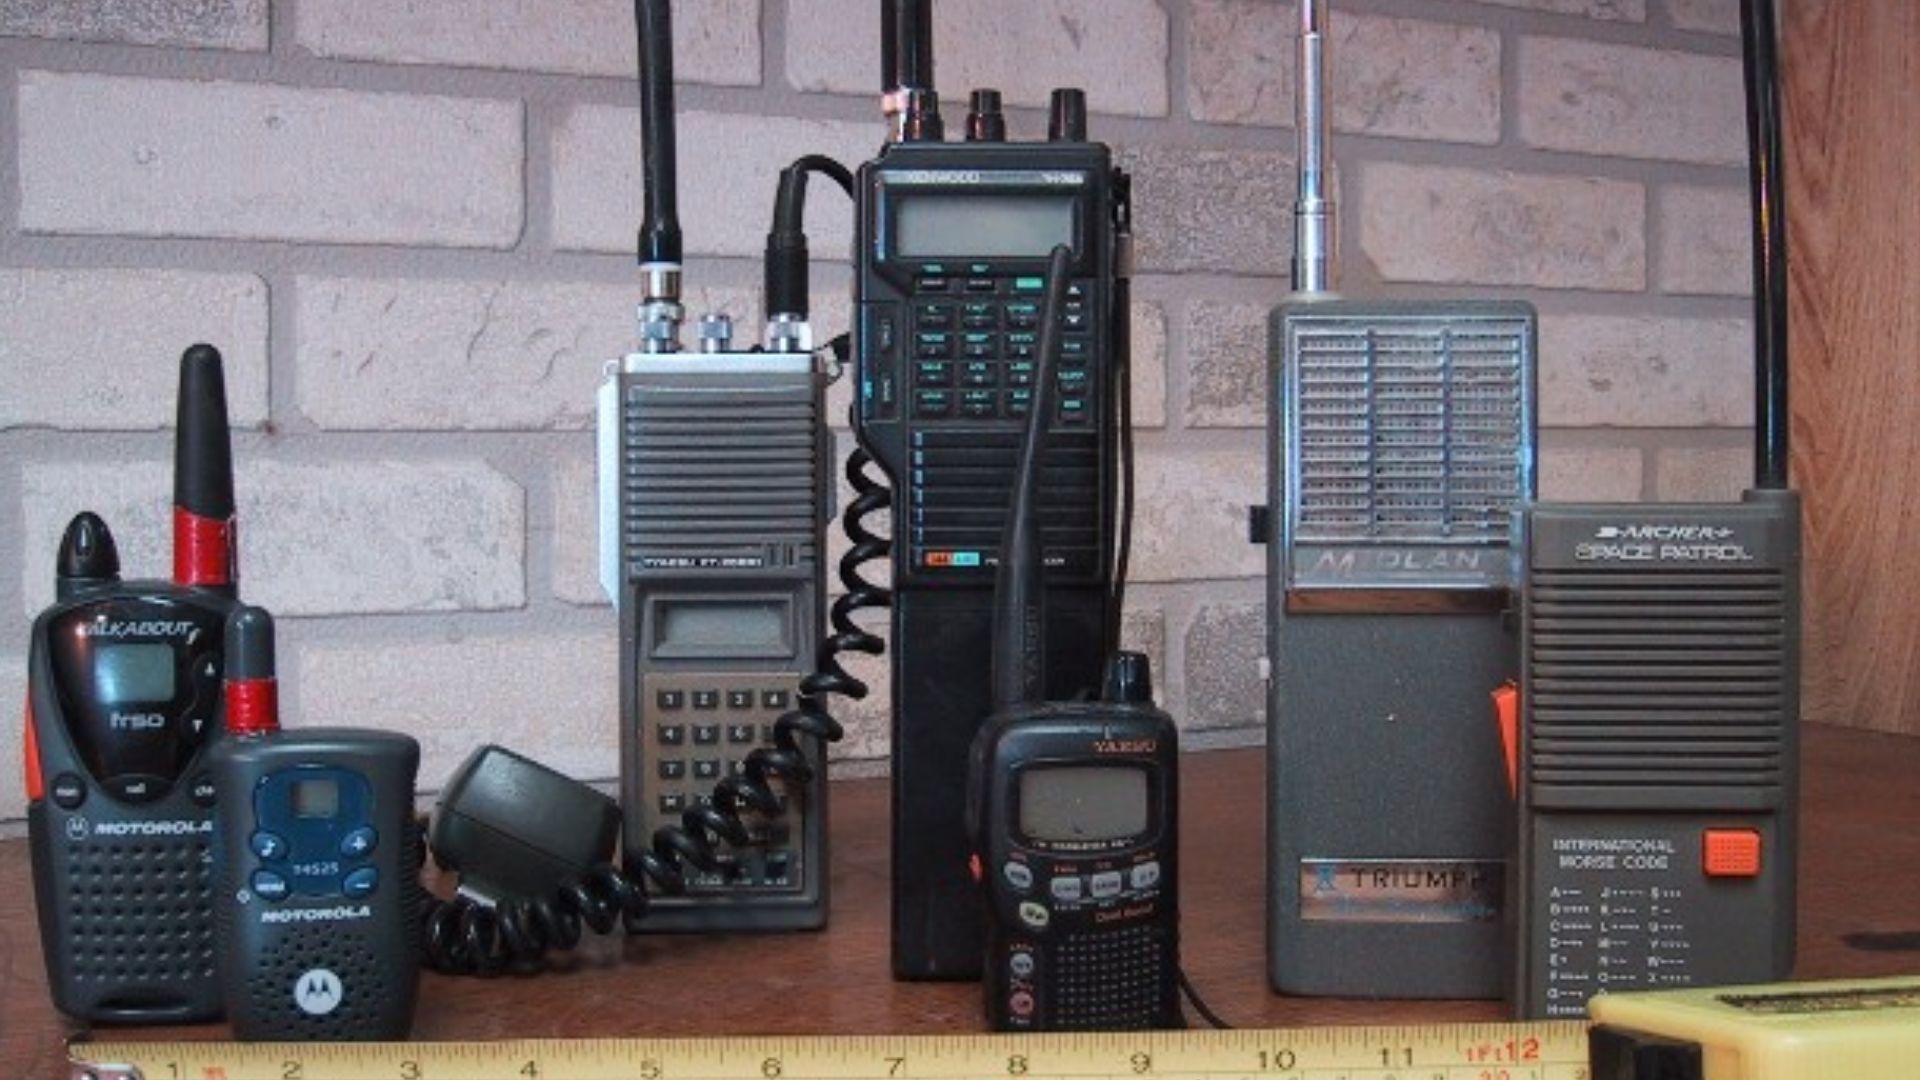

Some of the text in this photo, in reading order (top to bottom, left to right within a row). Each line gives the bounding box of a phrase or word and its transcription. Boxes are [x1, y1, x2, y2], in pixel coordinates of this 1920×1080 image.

[1575, 543, 1753, 560] SPACE PATROL
[1313, 550, 1484, 570] MDLAN
[79, 621, 194, 637] ALKABOUT
[94, 820, 213, 835] MOTOROLA
[1553, 839, 1675, 853] INTERNATIONAL
[1559, 855, 1669, 869] MORSE CODE
[261, 905, 371, 924] MOTOROLA
[168, 1061, 178, 1079] 1
[282, 1061, 301, 1080] 2
[400, 1060, 421, 1080] 3
[520, 1060, 538, 1079] 4
[641, 1058, 661, 1080] 5
[761, 1057, 782, 1079] 6
[884, 1057, 904, 1077] 7
[1007, 1055, 1028, 1075] 8
[1130, 1052, 1150, 1074] 9
[1258, 1049, 1296, 1070] 10
[1380, 1047, 1412, 1066] 11
[1505, 1037, 1540, 1061] 12
